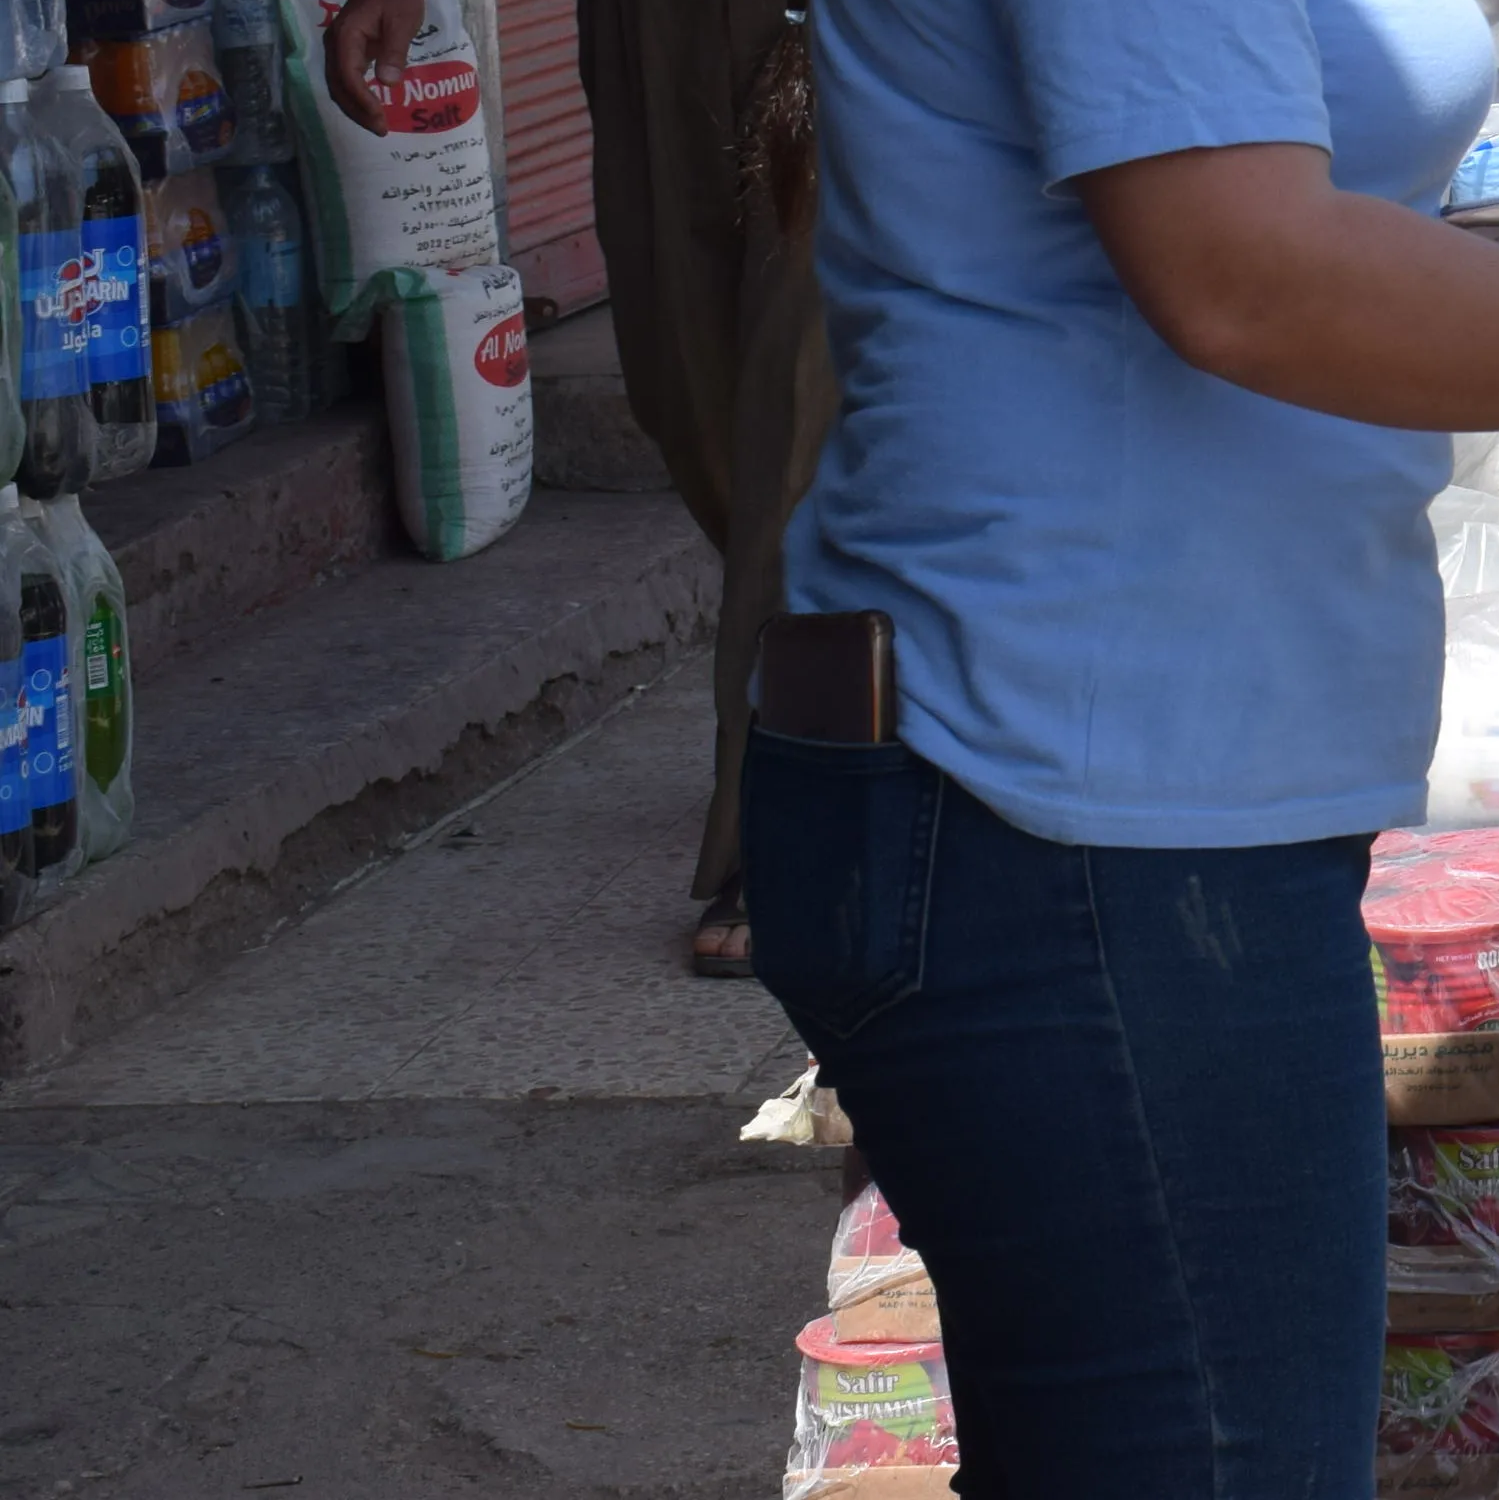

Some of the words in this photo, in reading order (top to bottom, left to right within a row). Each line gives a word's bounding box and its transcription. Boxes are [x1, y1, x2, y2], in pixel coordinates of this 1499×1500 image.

[410, 104, 462, 134] Salt
[481, 334, 499, 363] Al
[836, 1371, 900, 1394] Safir
